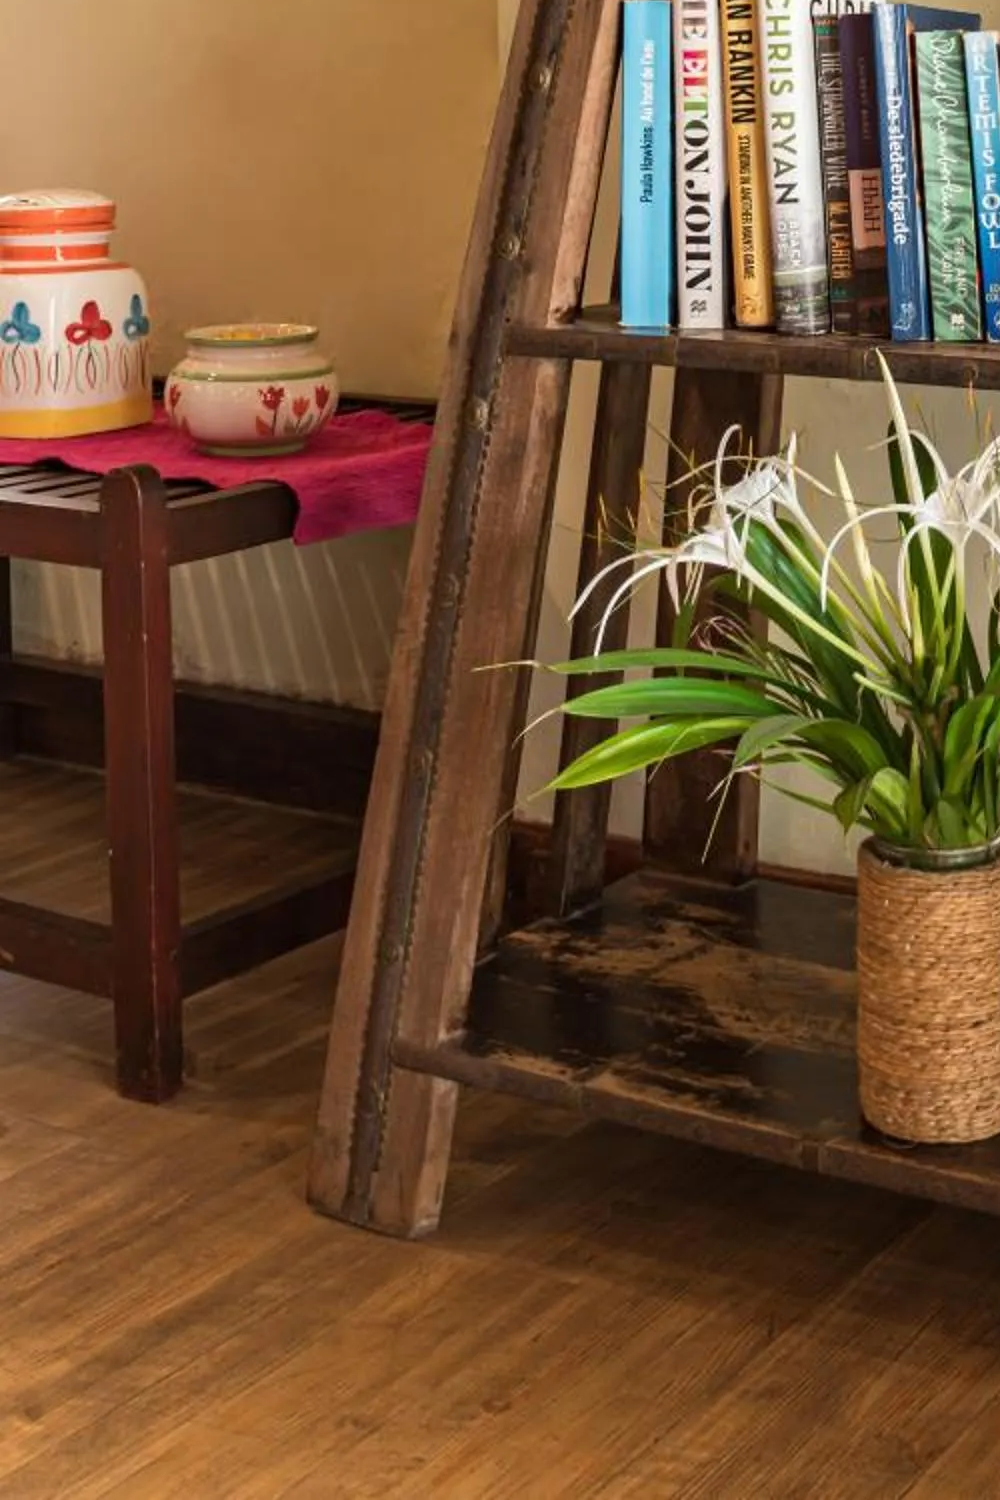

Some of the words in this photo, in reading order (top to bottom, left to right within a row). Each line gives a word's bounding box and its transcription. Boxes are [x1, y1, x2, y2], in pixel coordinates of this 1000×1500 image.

[683, 50, 711, 173] ELTON
[727, 31, 756, 125] RANKIN
[971, 37, 996, 167] ARTEMIS
[639, 172, 654, 203] Paula
[640, 127, 654, 171] Hawkins
[770, 110, 799, 206] RYAN
[684, 179, 713, 293] JOHN
[831, 232, 850, 280] CARTER
